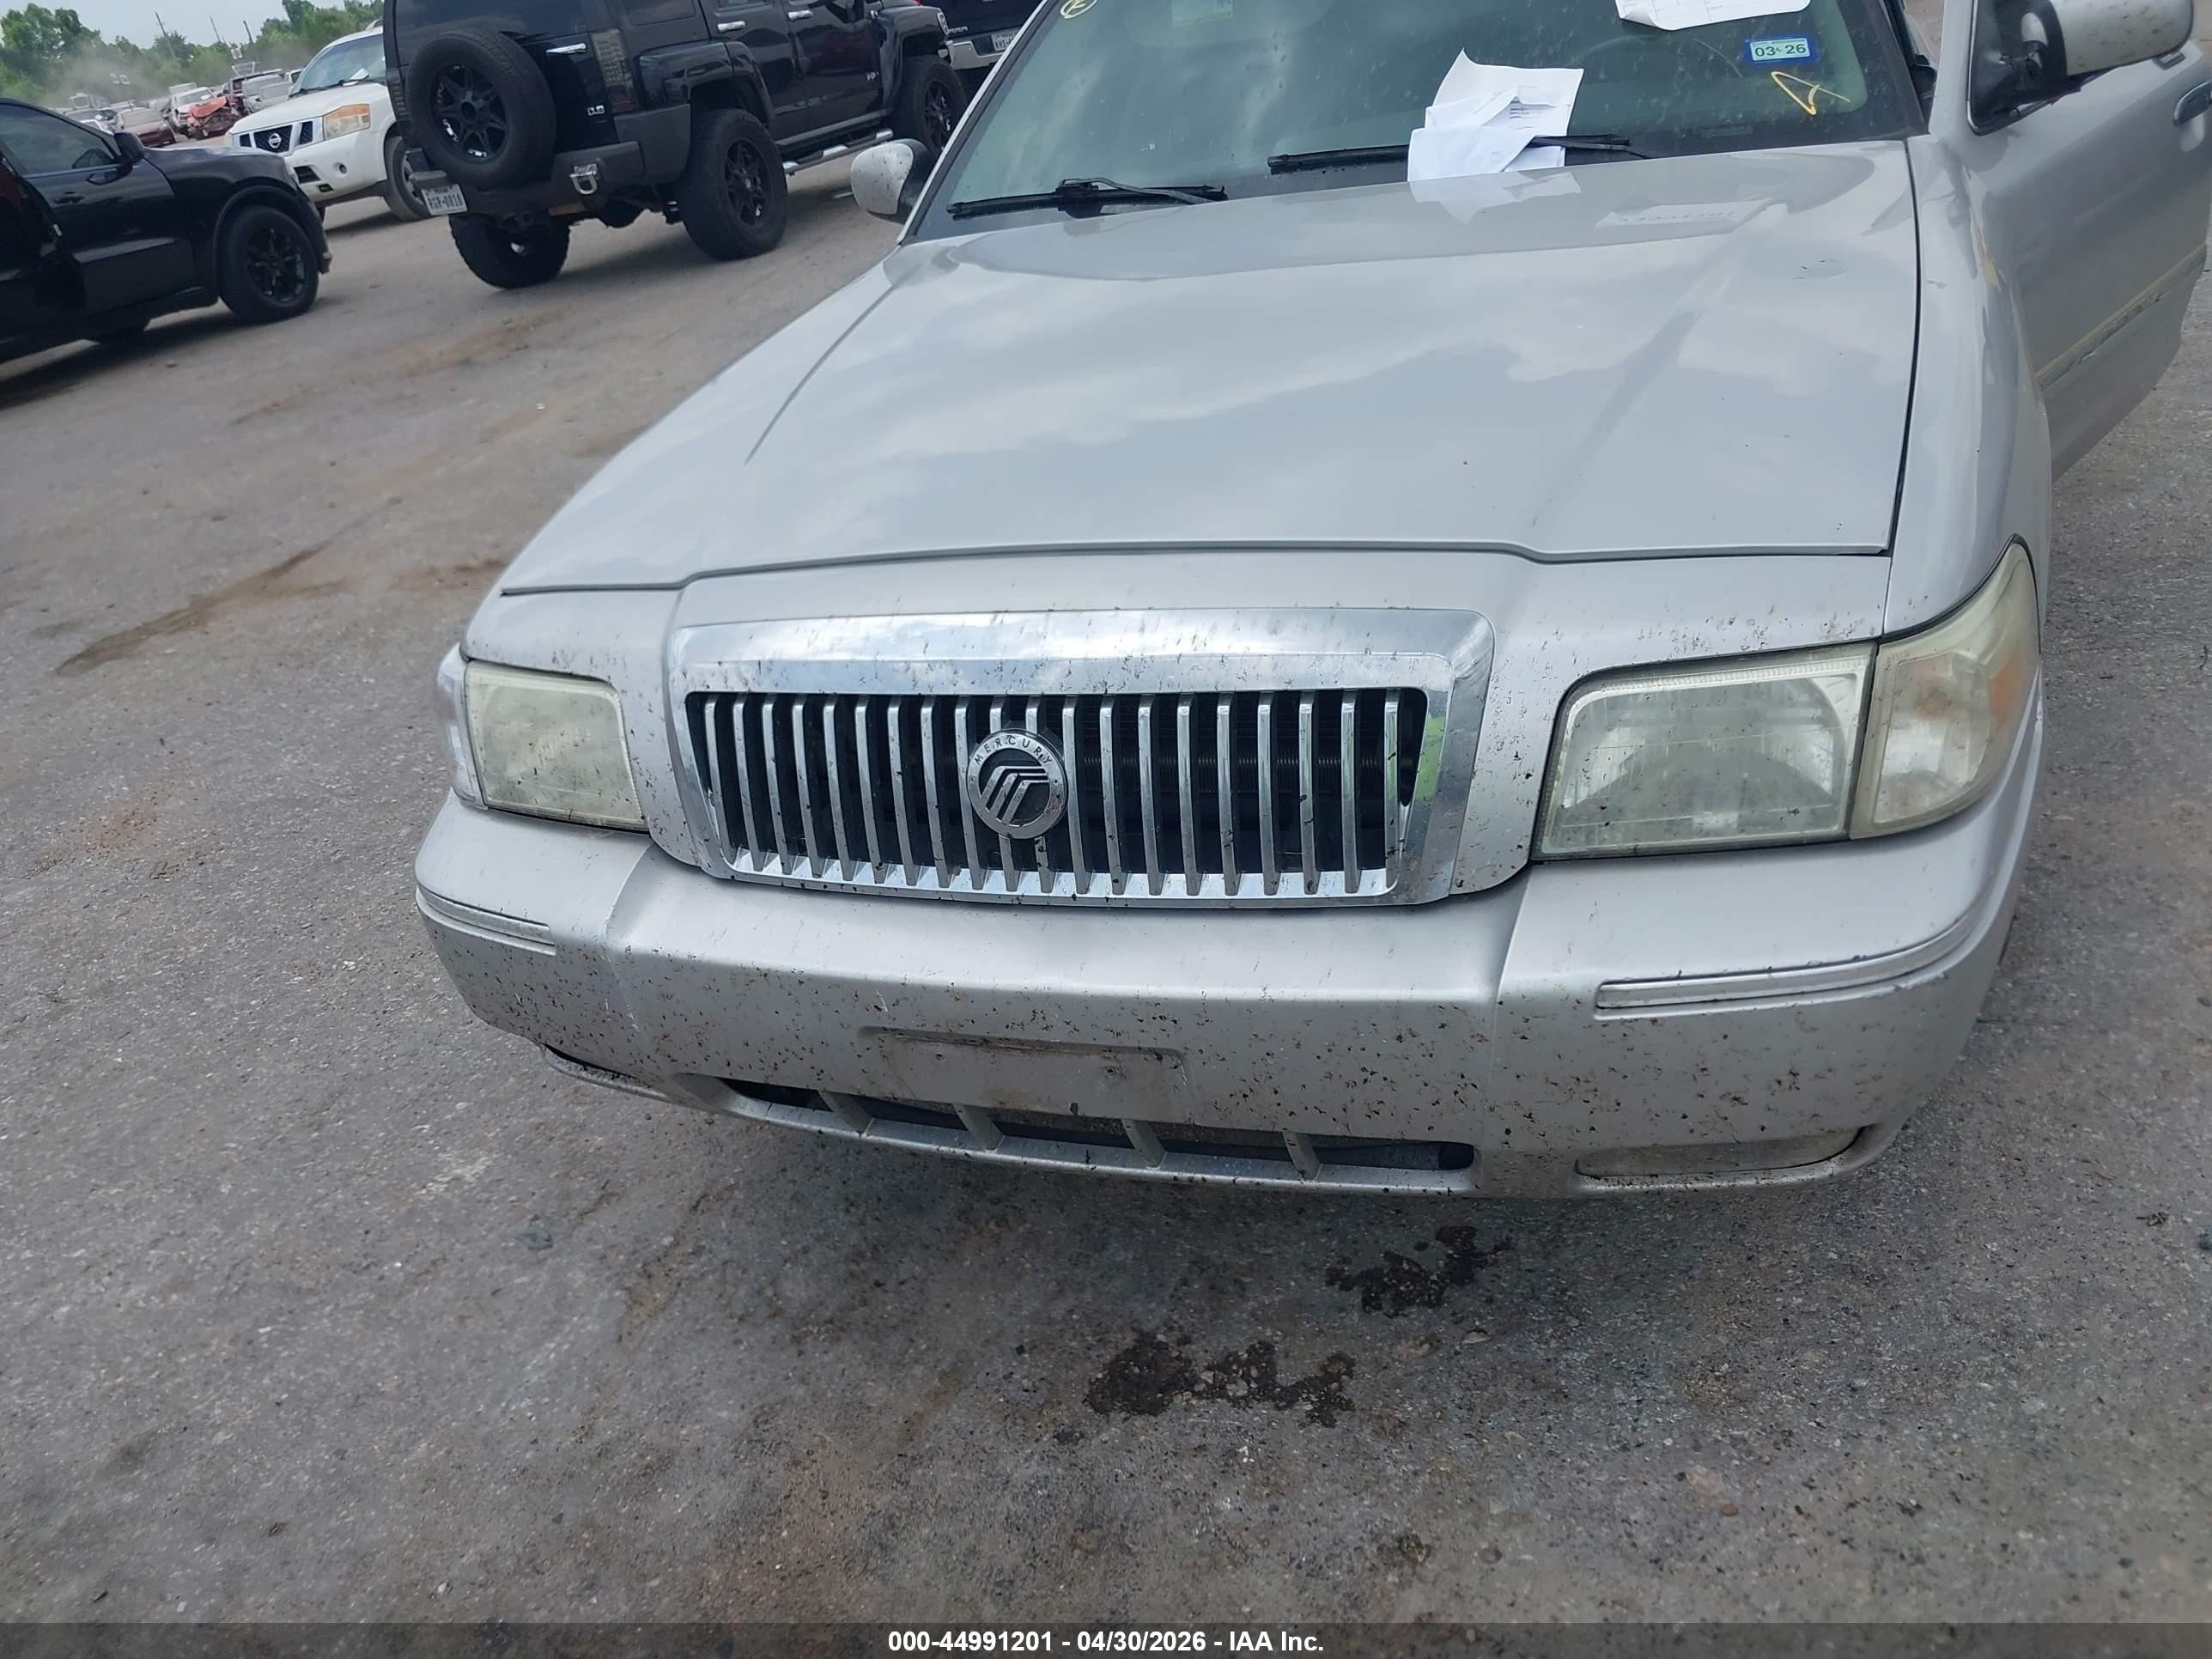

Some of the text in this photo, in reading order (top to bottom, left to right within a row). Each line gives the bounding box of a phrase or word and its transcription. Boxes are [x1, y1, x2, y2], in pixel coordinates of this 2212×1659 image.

[1754, 43, 1807, 57] 03 26
[974, 734, 1053, 766] MERCURY
